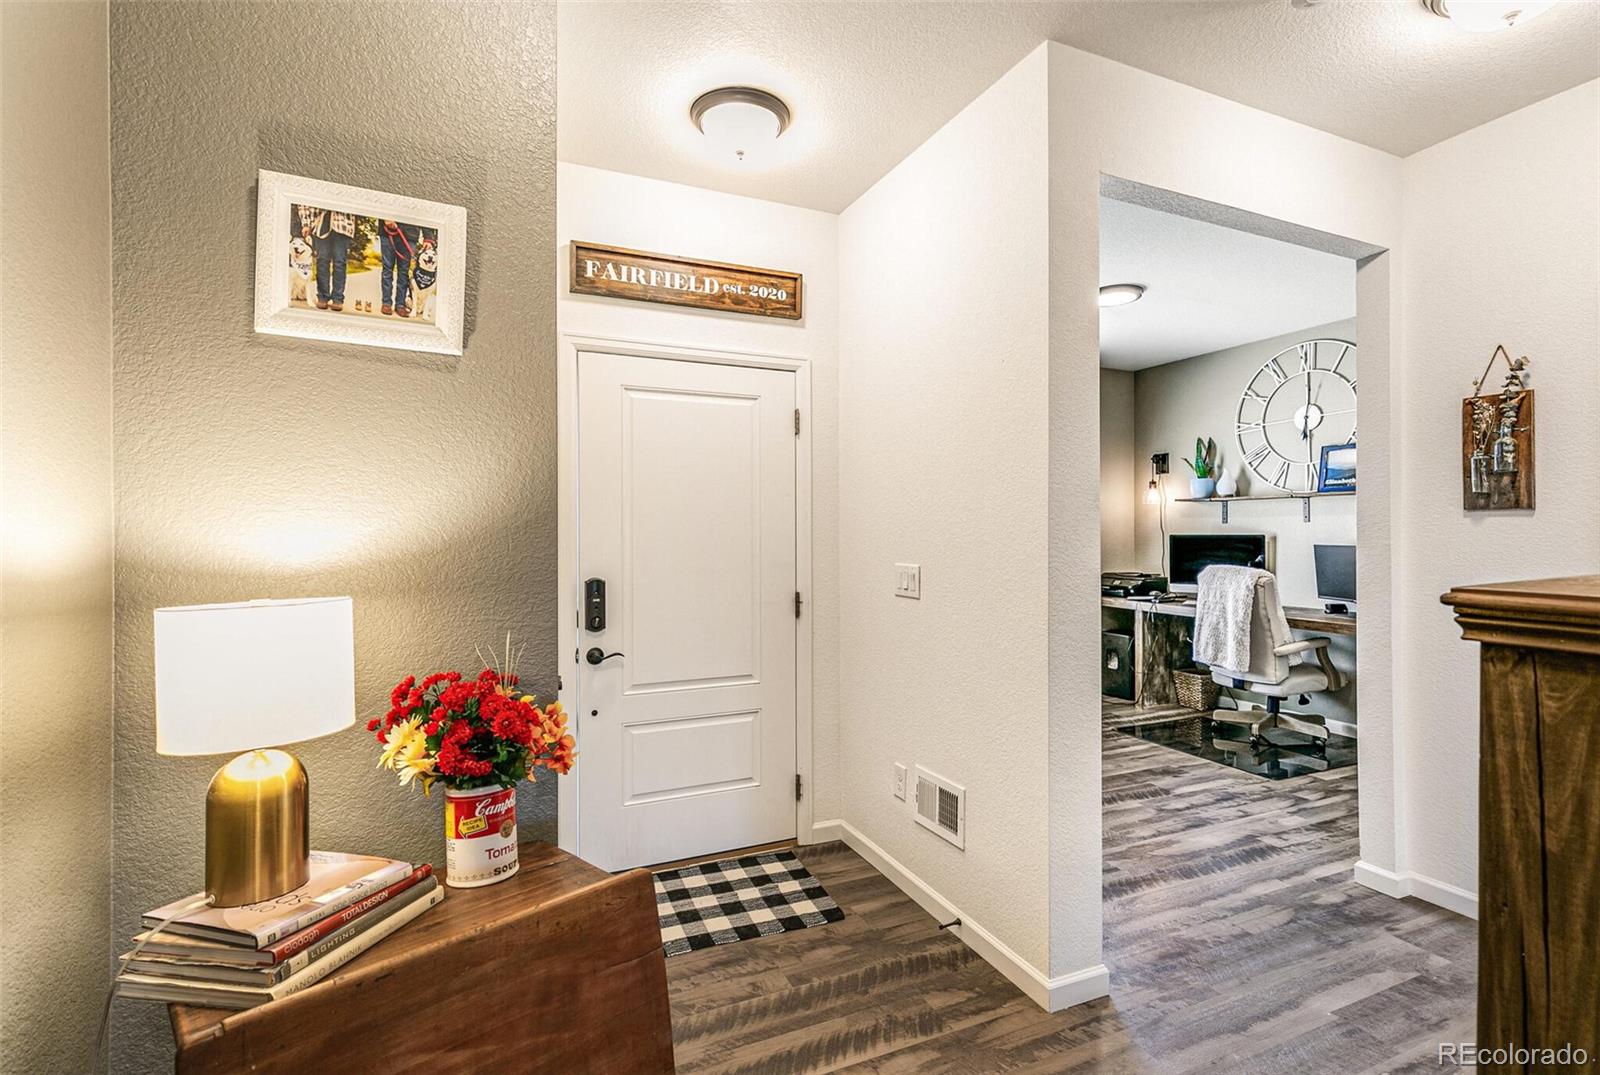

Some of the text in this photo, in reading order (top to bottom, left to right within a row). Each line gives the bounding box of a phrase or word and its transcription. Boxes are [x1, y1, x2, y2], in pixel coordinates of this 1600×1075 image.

[584, 259, 787, 301] FAIRFIELD est. 2020
[485, 841, 517, 860] Toma
[311, 928, 356, 959] LIGHTING
[285, 945, 364, 997] MANOLO BLAHNIK
